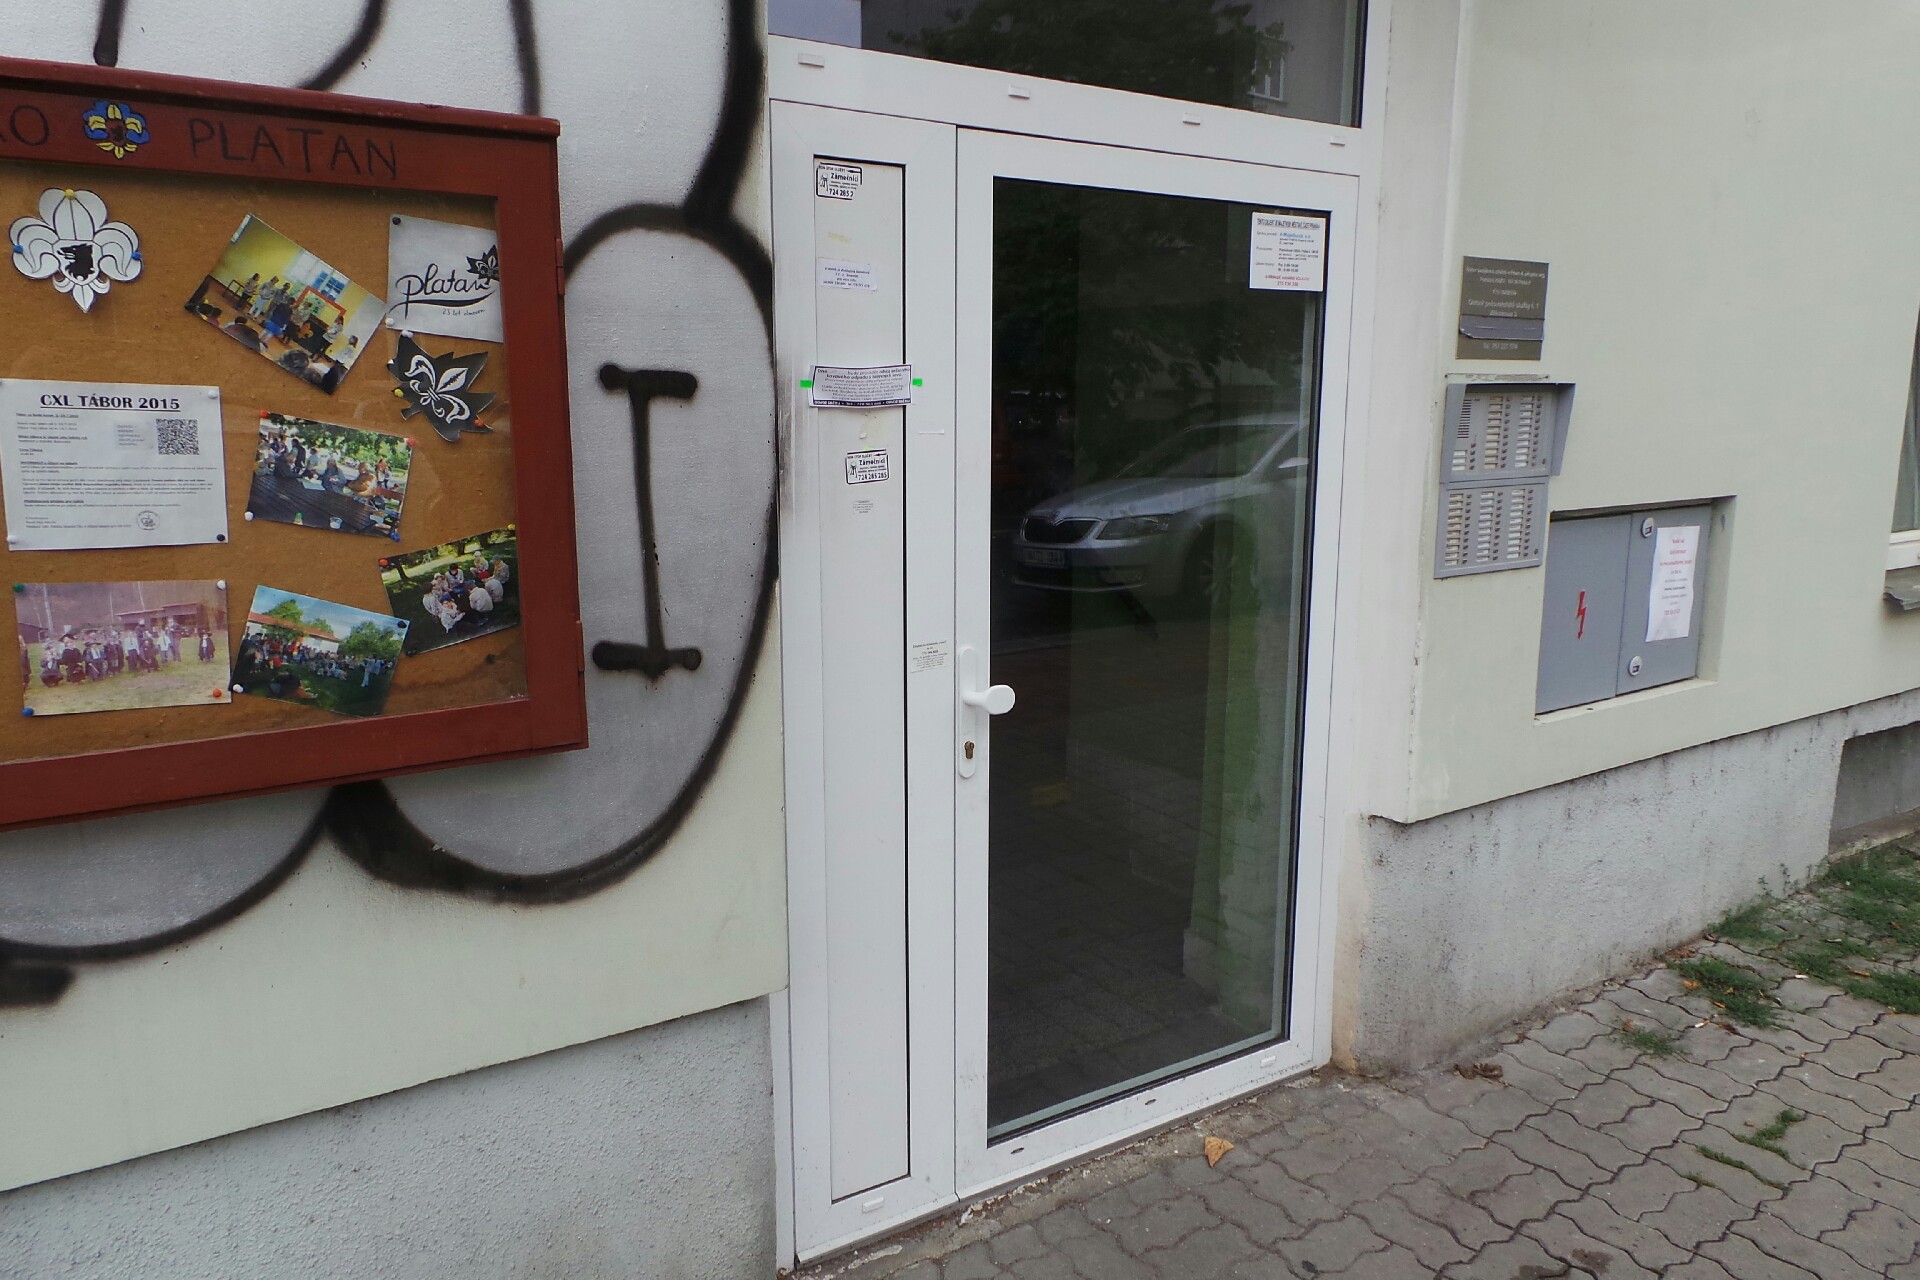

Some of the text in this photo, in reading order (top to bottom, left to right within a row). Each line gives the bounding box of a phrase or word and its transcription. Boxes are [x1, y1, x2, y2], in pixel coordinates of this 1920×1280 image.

[0, 104, 399, 181] O PLATAN
[394, 263, 491, 320] platan
[40, 393, 181, 410] CXL TÁBOR 2015
